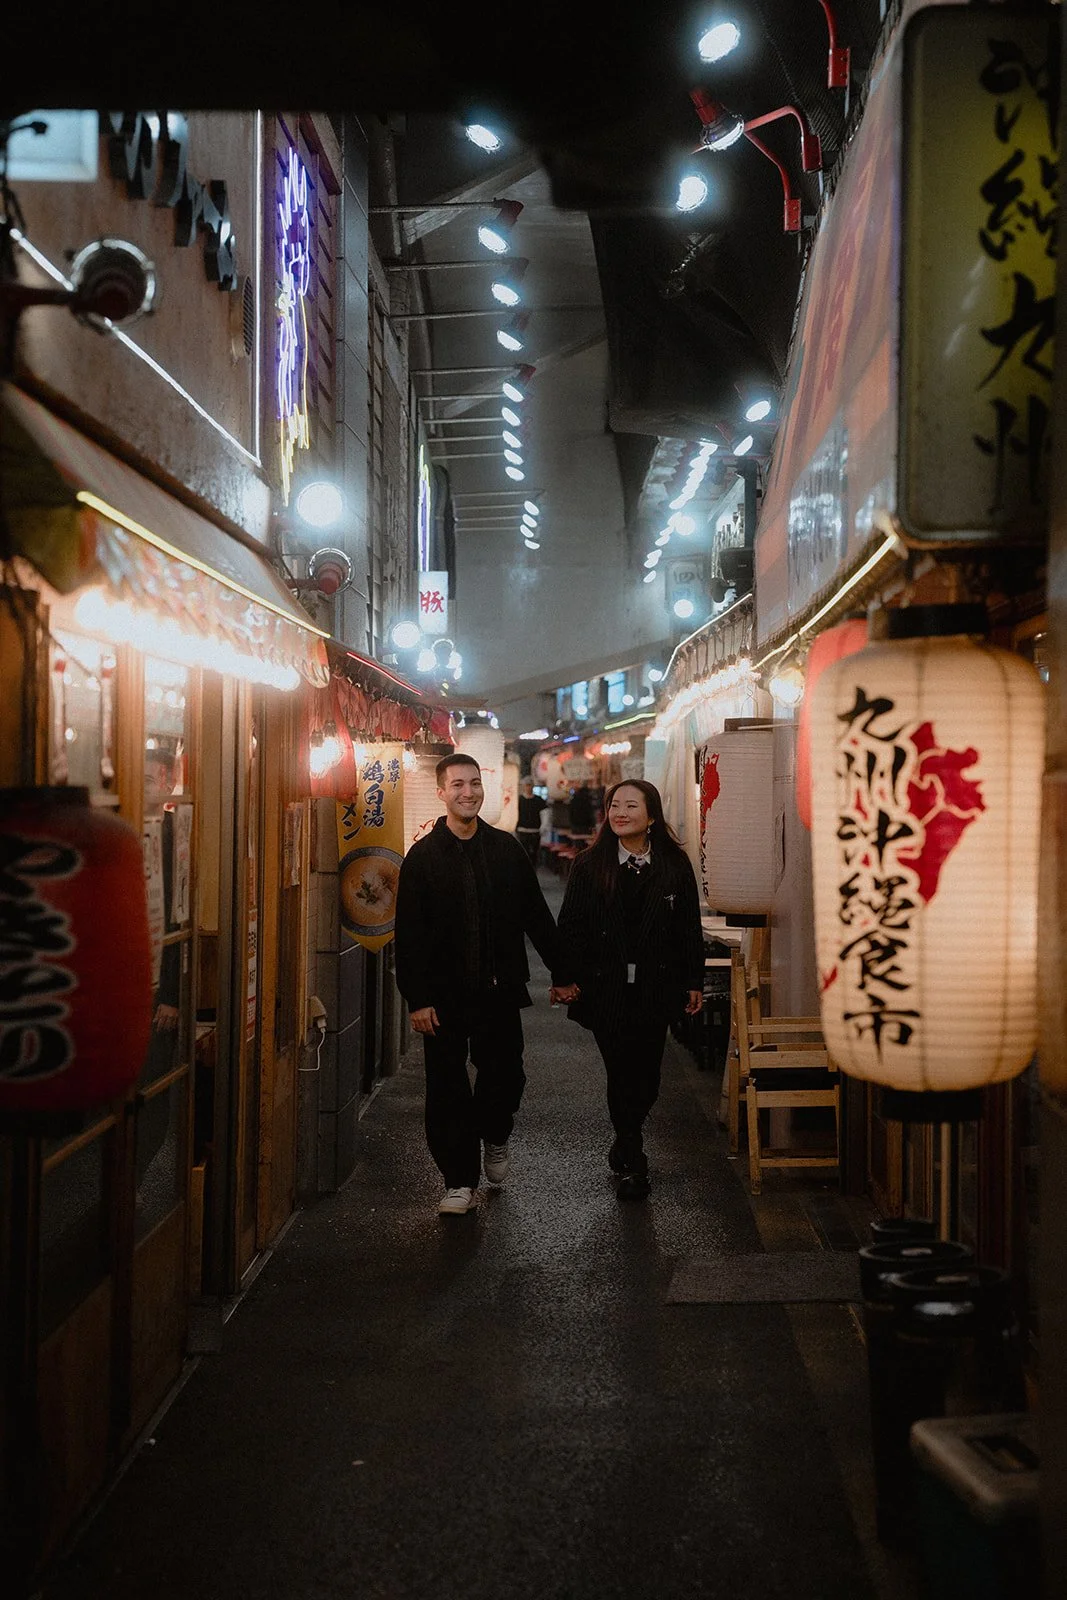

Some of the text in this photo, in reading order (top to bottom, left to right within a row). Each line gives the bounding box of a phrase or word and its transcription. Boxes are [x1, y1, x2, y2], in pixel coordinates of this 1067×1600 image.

[419, 590, 445, 614] 豚
[837, 686, 920, 1064] 九州沖縄食市
